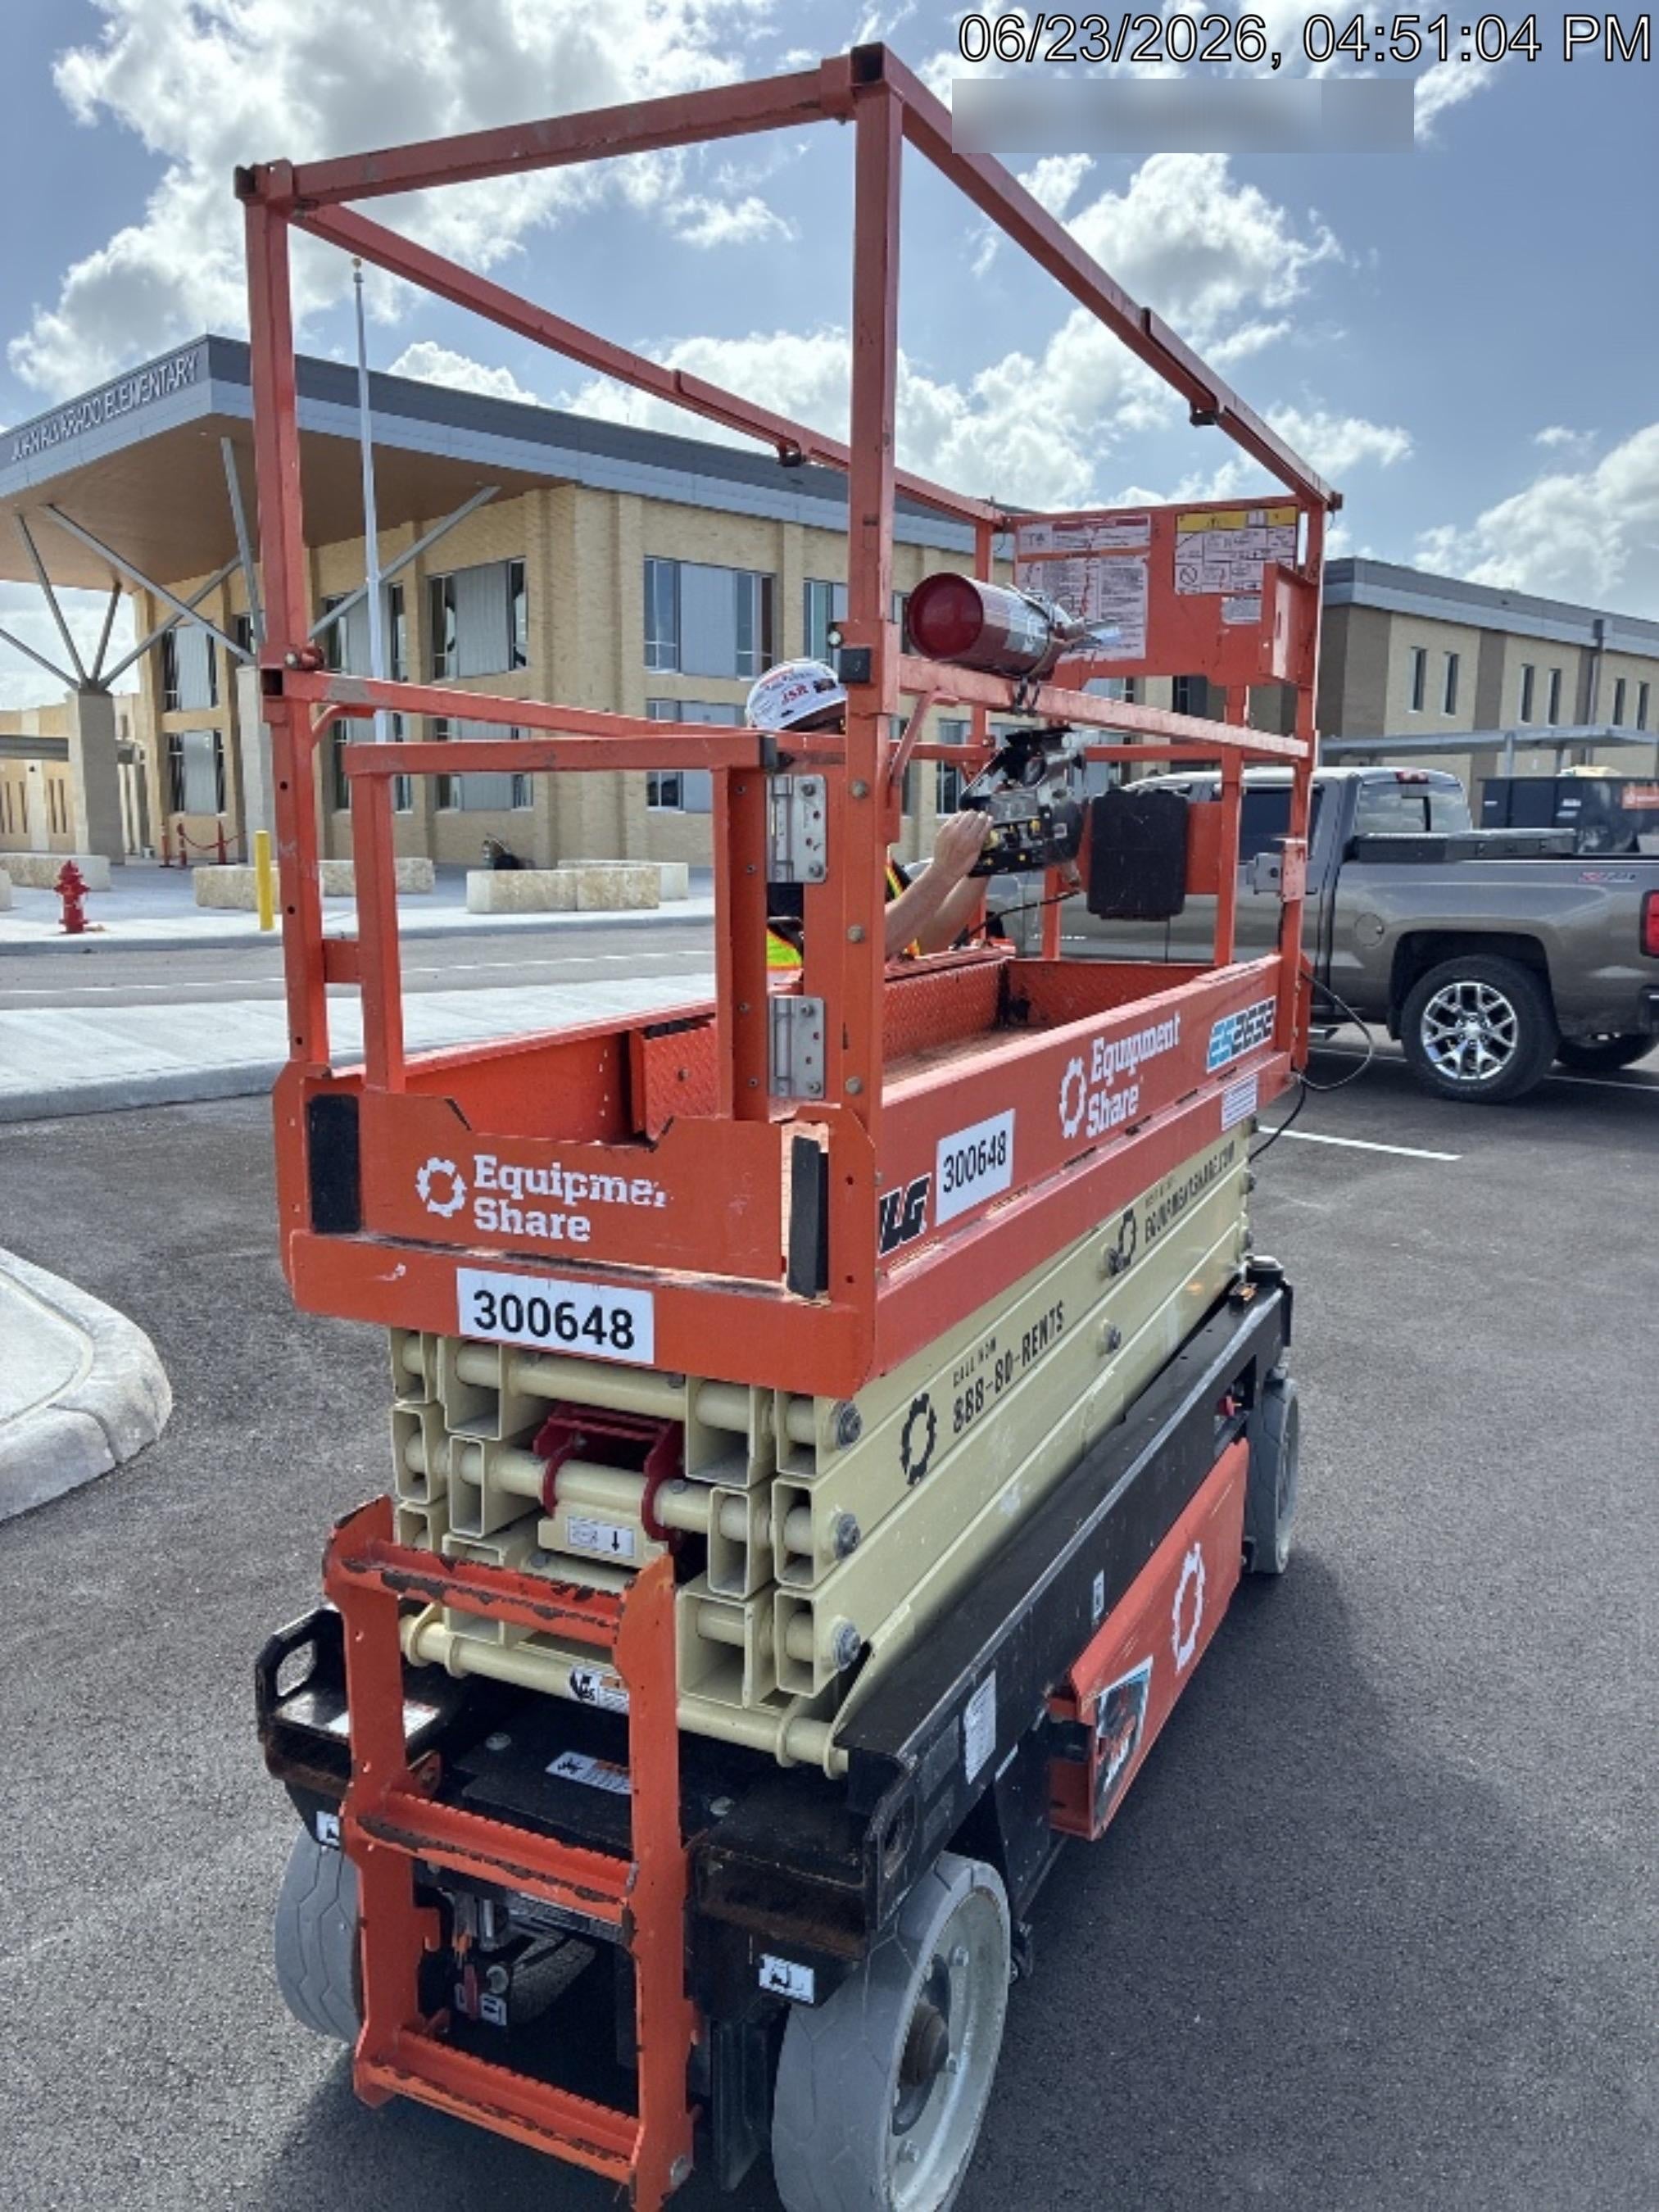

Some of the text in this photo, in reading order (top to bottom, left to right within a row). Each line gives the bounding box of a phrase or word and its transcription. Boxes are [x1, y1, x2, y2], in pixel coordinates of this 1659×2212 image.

[104, 351, 197, 419] ELEMENTARY
[1091, 1010, 1181, 1086] Equipment
[1086, 1083, 1139, 1138] Share
[943, 1130, 1006, 1193] 300648
[474, 1197, 590, 1241] Share
[474, 1290, 635, 1350] 300648
